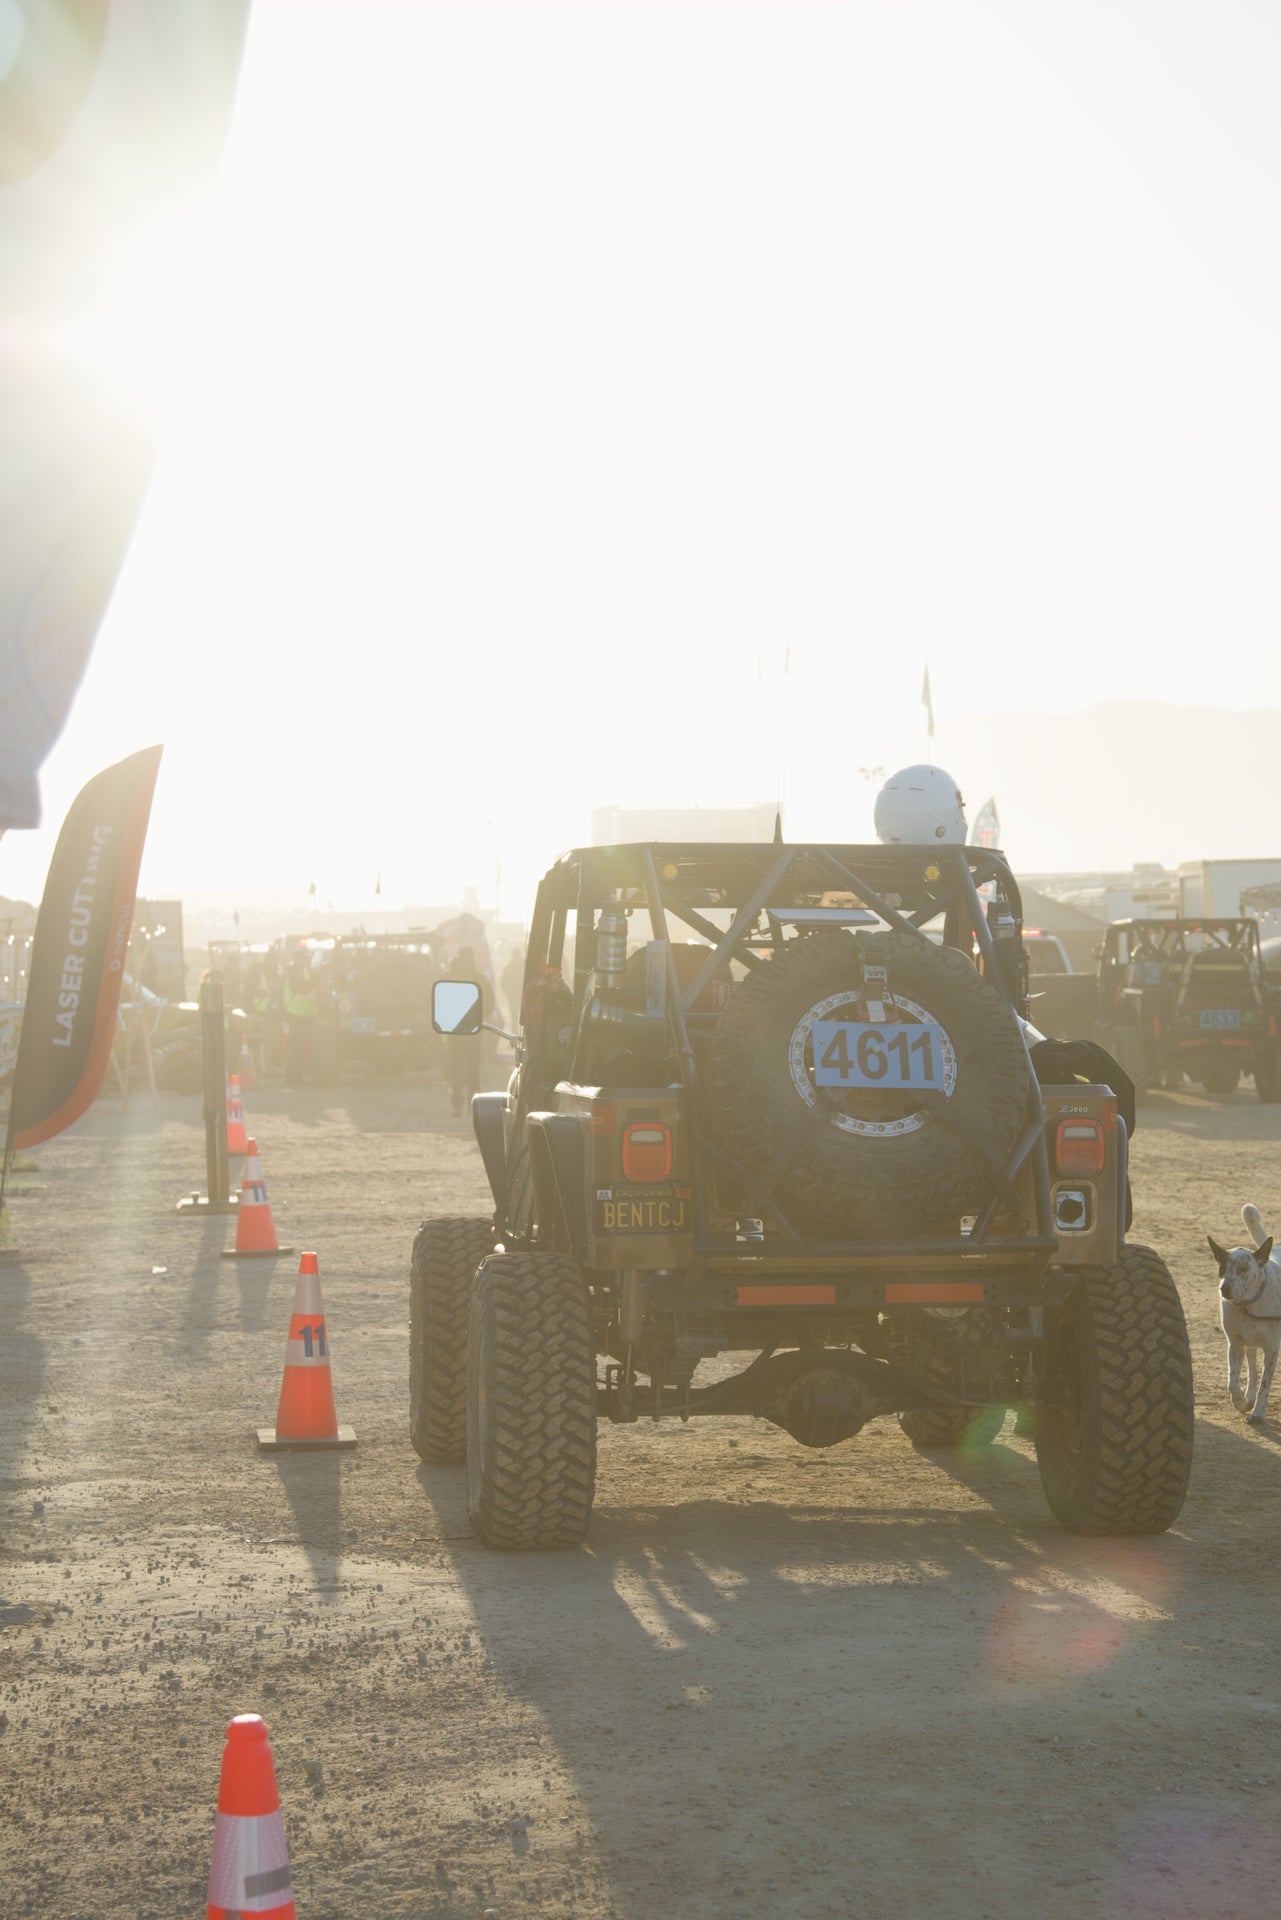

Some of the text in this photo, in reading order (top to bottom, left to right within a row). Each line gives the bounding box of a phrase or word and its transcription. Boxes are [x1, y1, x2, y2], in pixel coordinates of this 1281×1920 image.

[52, 954, 85, 1047] LASER
[820, 1029, 935, 1081] 4611
[1068, 1105, 1089, 1114] Jeep
[615, 1187, 674, 1199] CALIFORNIA
[603, 1202, 685, 1228] BENTCJ
